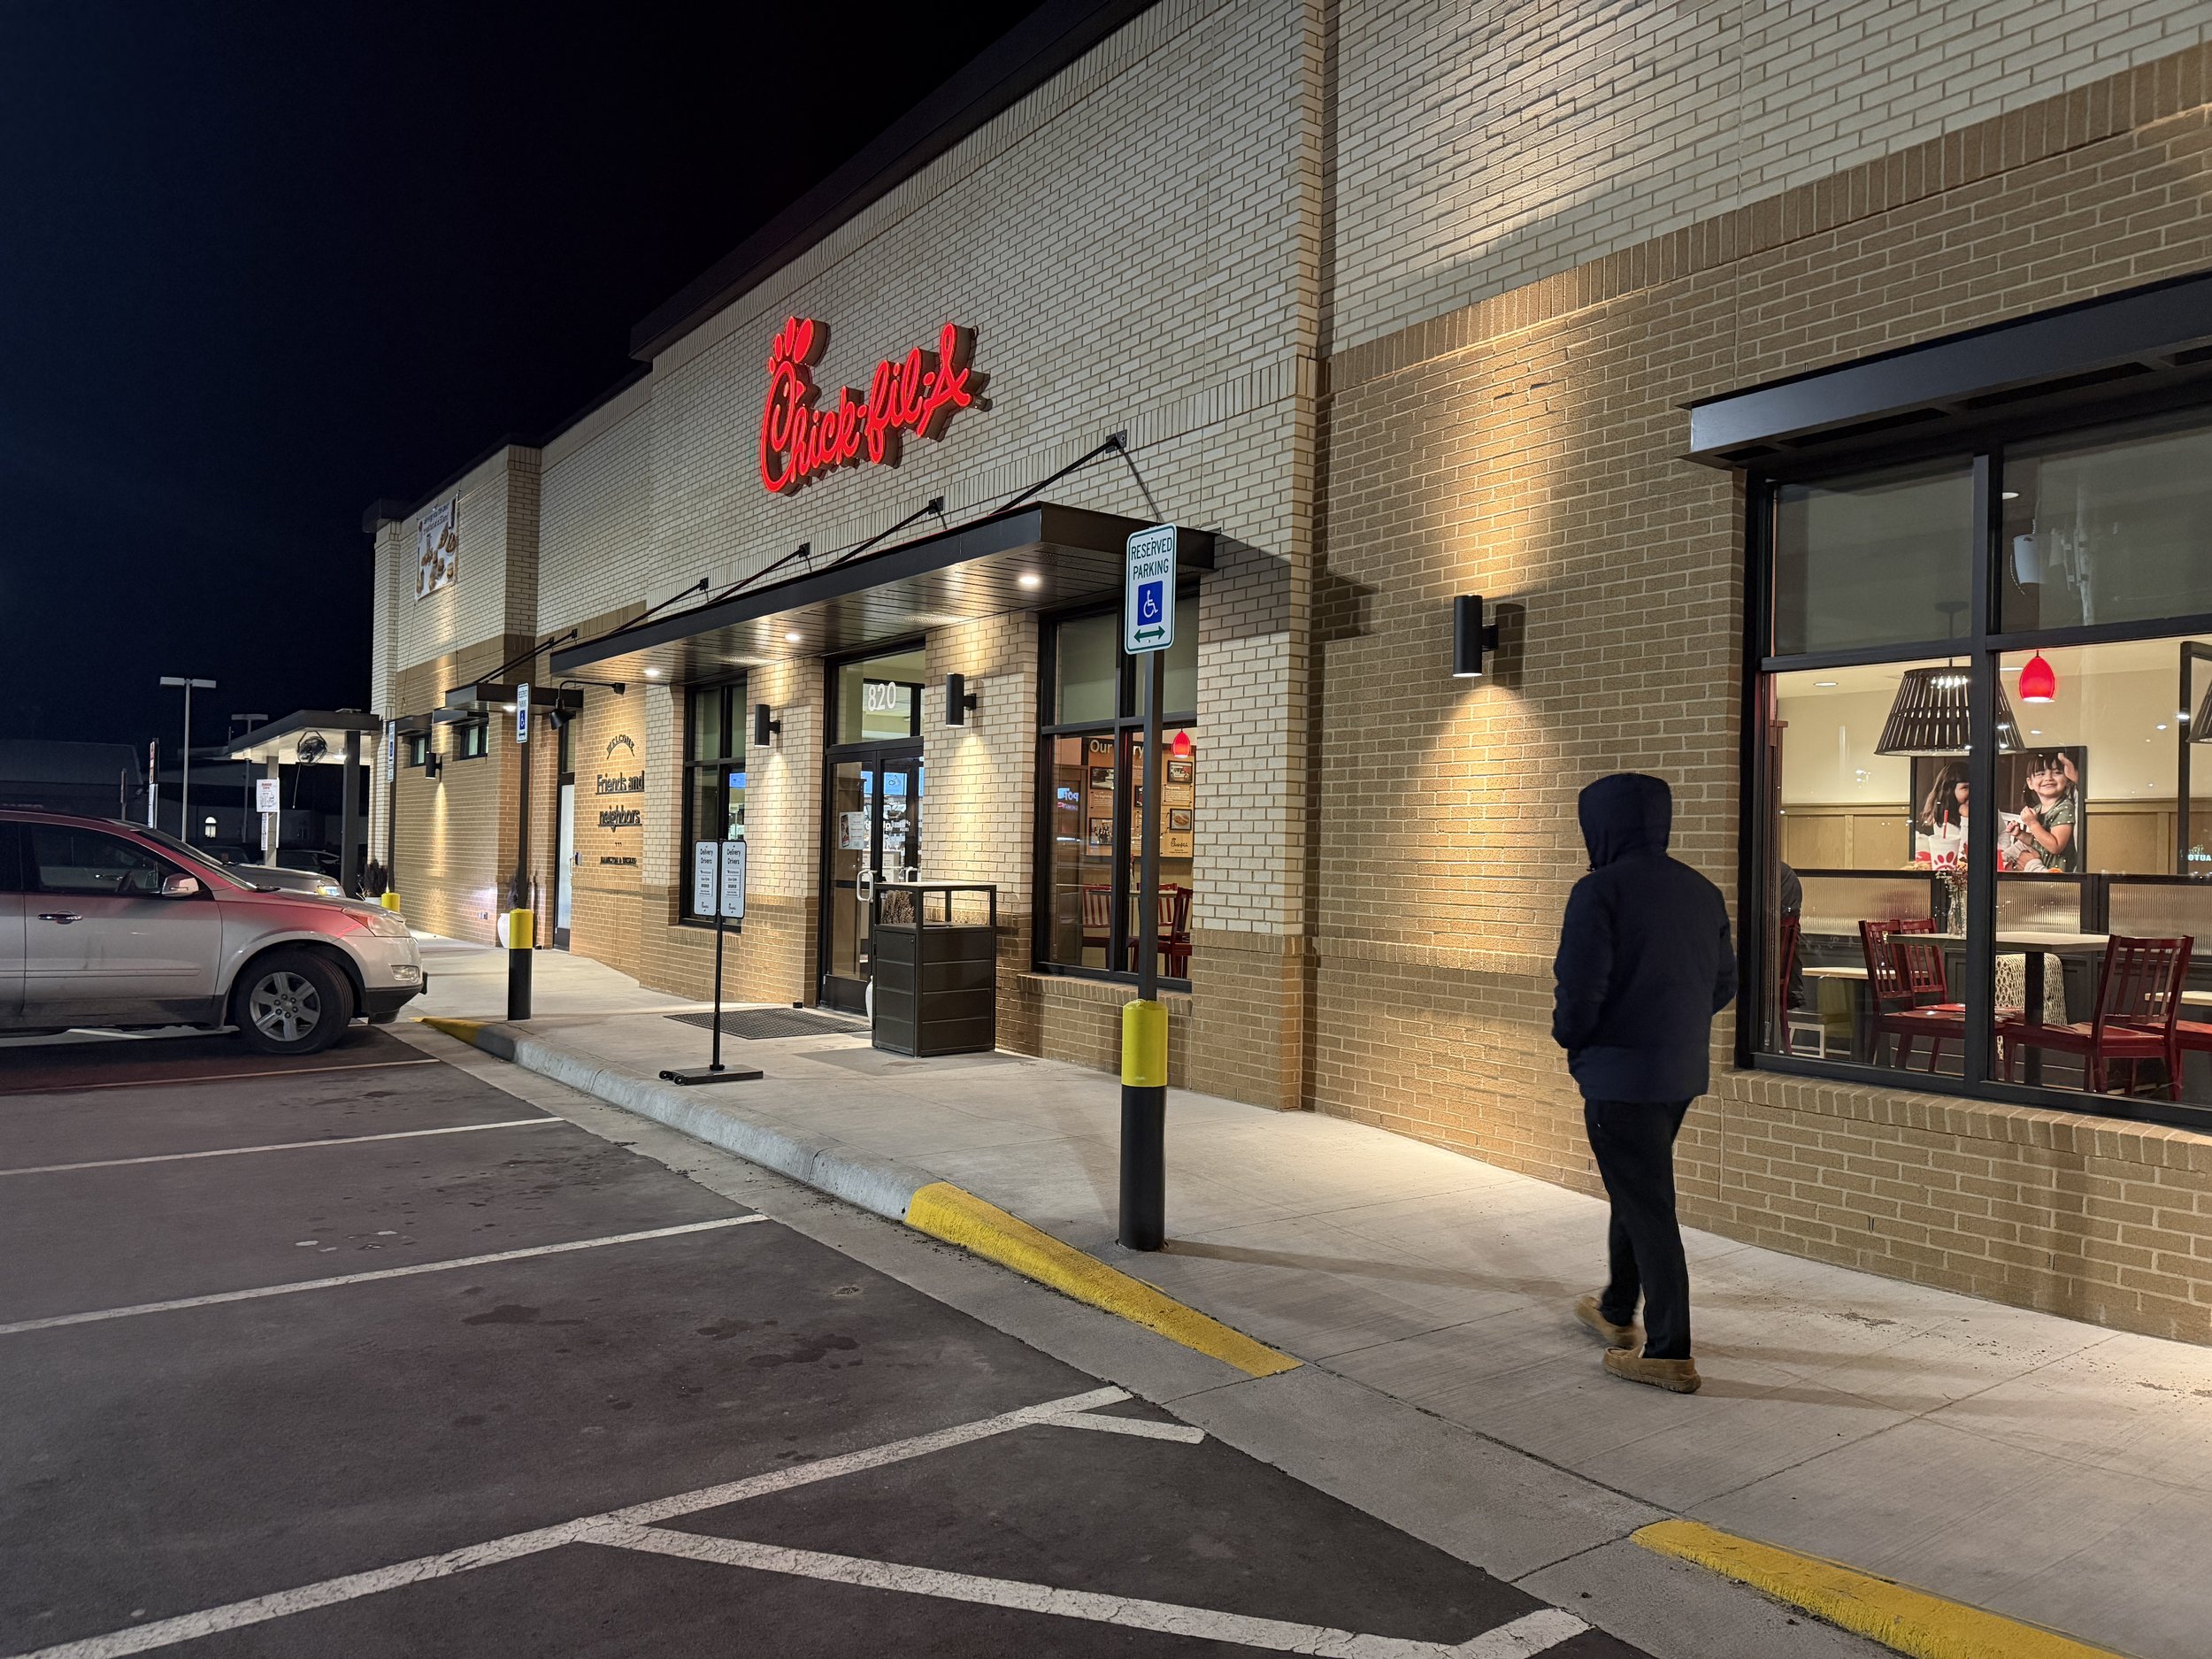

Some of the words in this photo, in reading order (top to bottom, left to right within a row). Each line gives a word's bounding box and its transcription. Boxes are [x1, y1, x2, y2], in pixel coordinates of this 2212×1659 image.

[761, 316, 972, 492] Chick-fil-A
[1131, 537, 1172, 560] RESERVED
[1133, 558, 1169, 580] PARKING
[868, 681, 897, 711] 820
[1090, 739, 1113, 753] Our
[597, 772, 626, 793] Friends
[628, 770, 645, 791] and
[599, 805, 641, 833] neighbors
